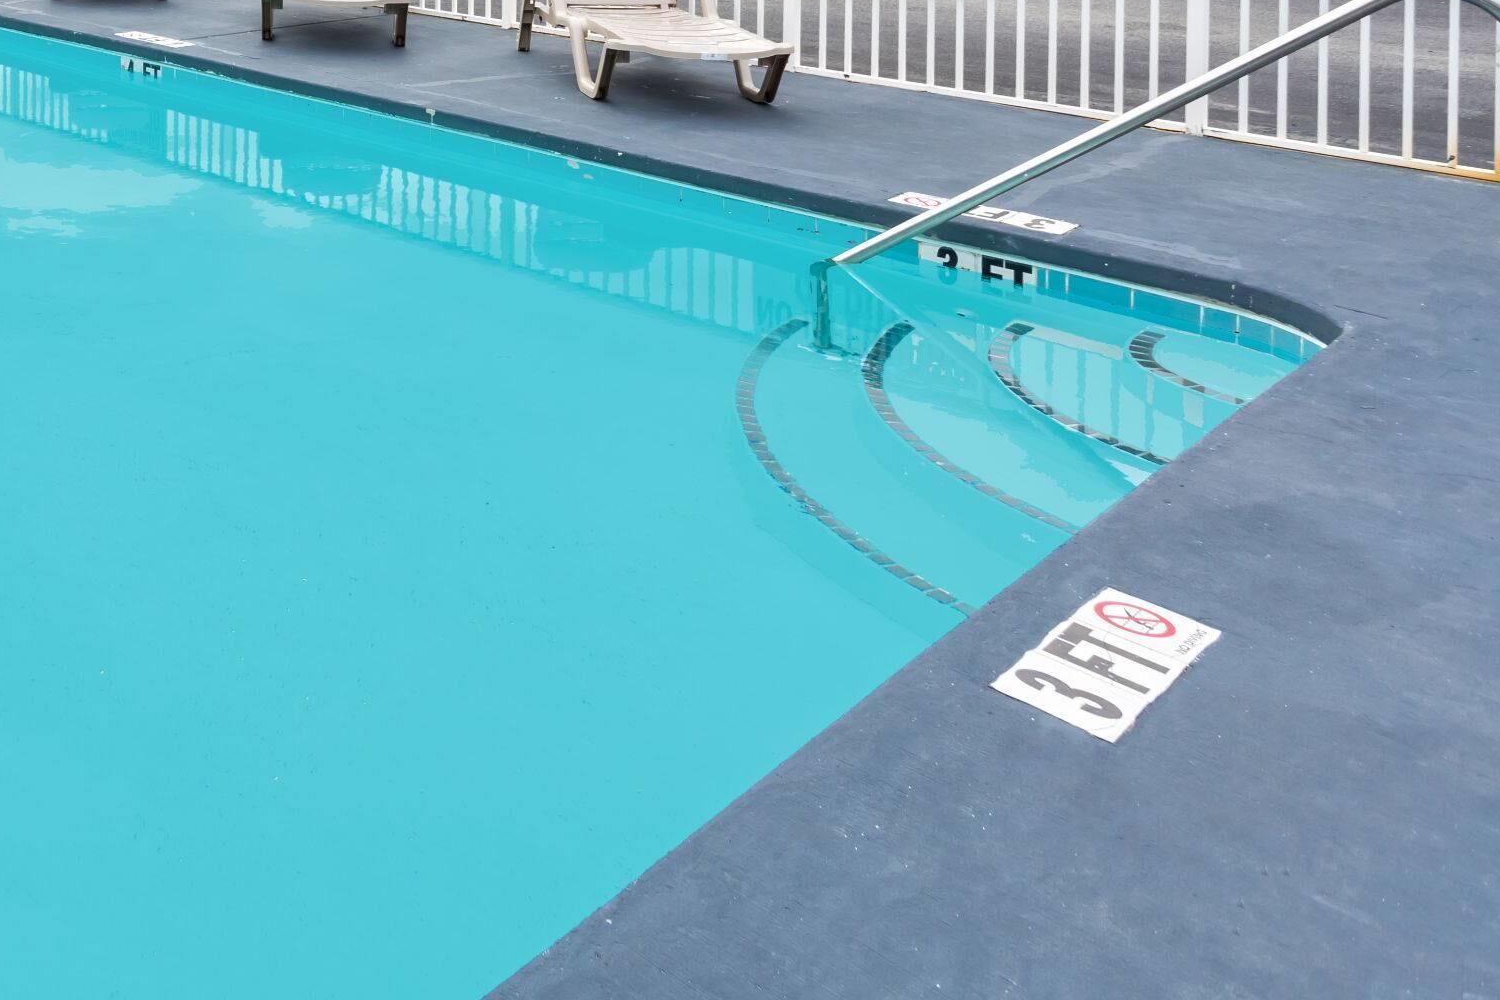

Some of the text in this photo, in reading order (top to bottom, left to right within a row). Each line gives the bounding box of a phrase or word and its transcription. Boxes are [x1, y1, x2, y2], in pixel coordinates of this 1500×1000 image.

[981, 254, 1033, 288] FT
[1014, 621, 1171, 720] 3 FT
